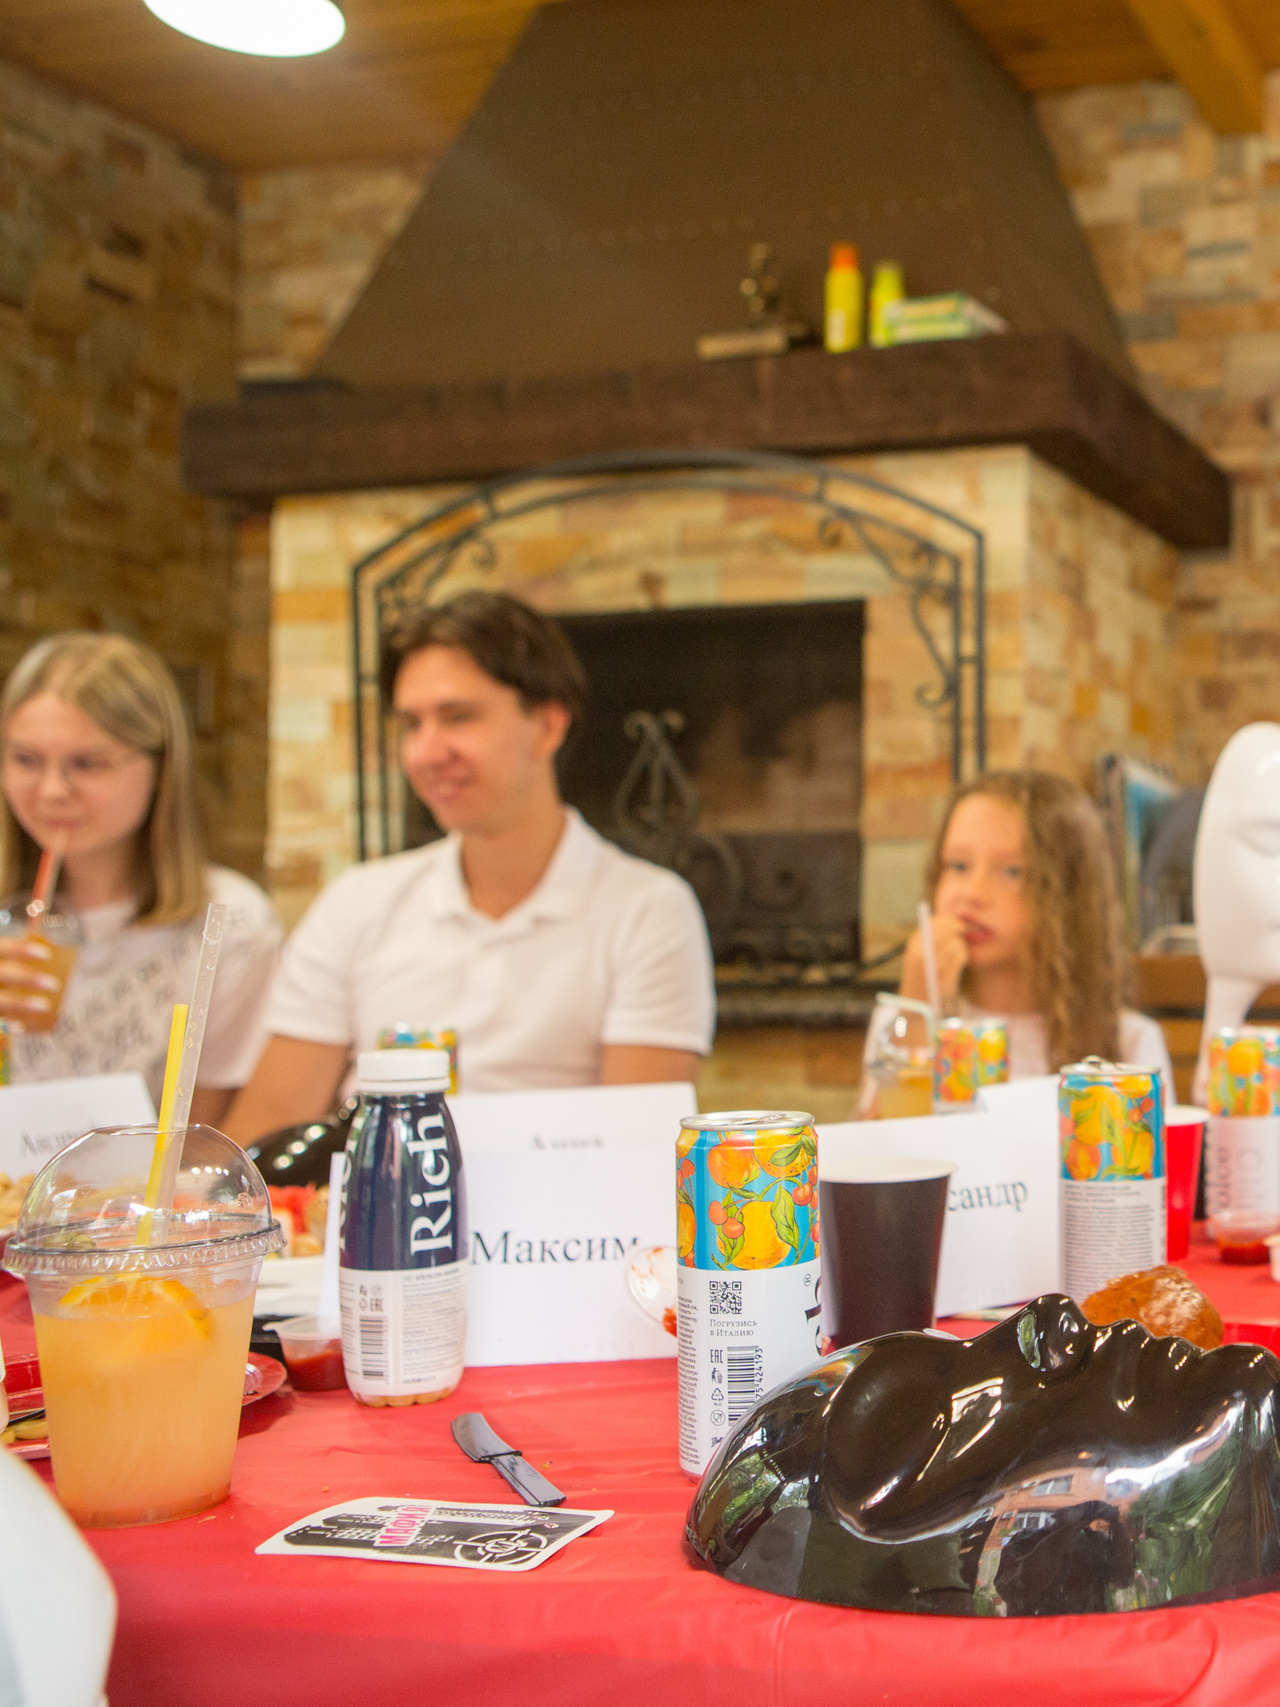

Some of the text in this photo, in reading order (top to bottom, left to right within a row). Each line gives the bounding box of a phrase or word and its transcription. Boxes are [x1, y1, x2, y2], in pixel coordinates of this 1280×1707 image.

[406, 1112, 453, 1256] Rich
[470, 1230, 640, 1265] Максим
[378, 1506, 433, 1545] МАФИЯ
